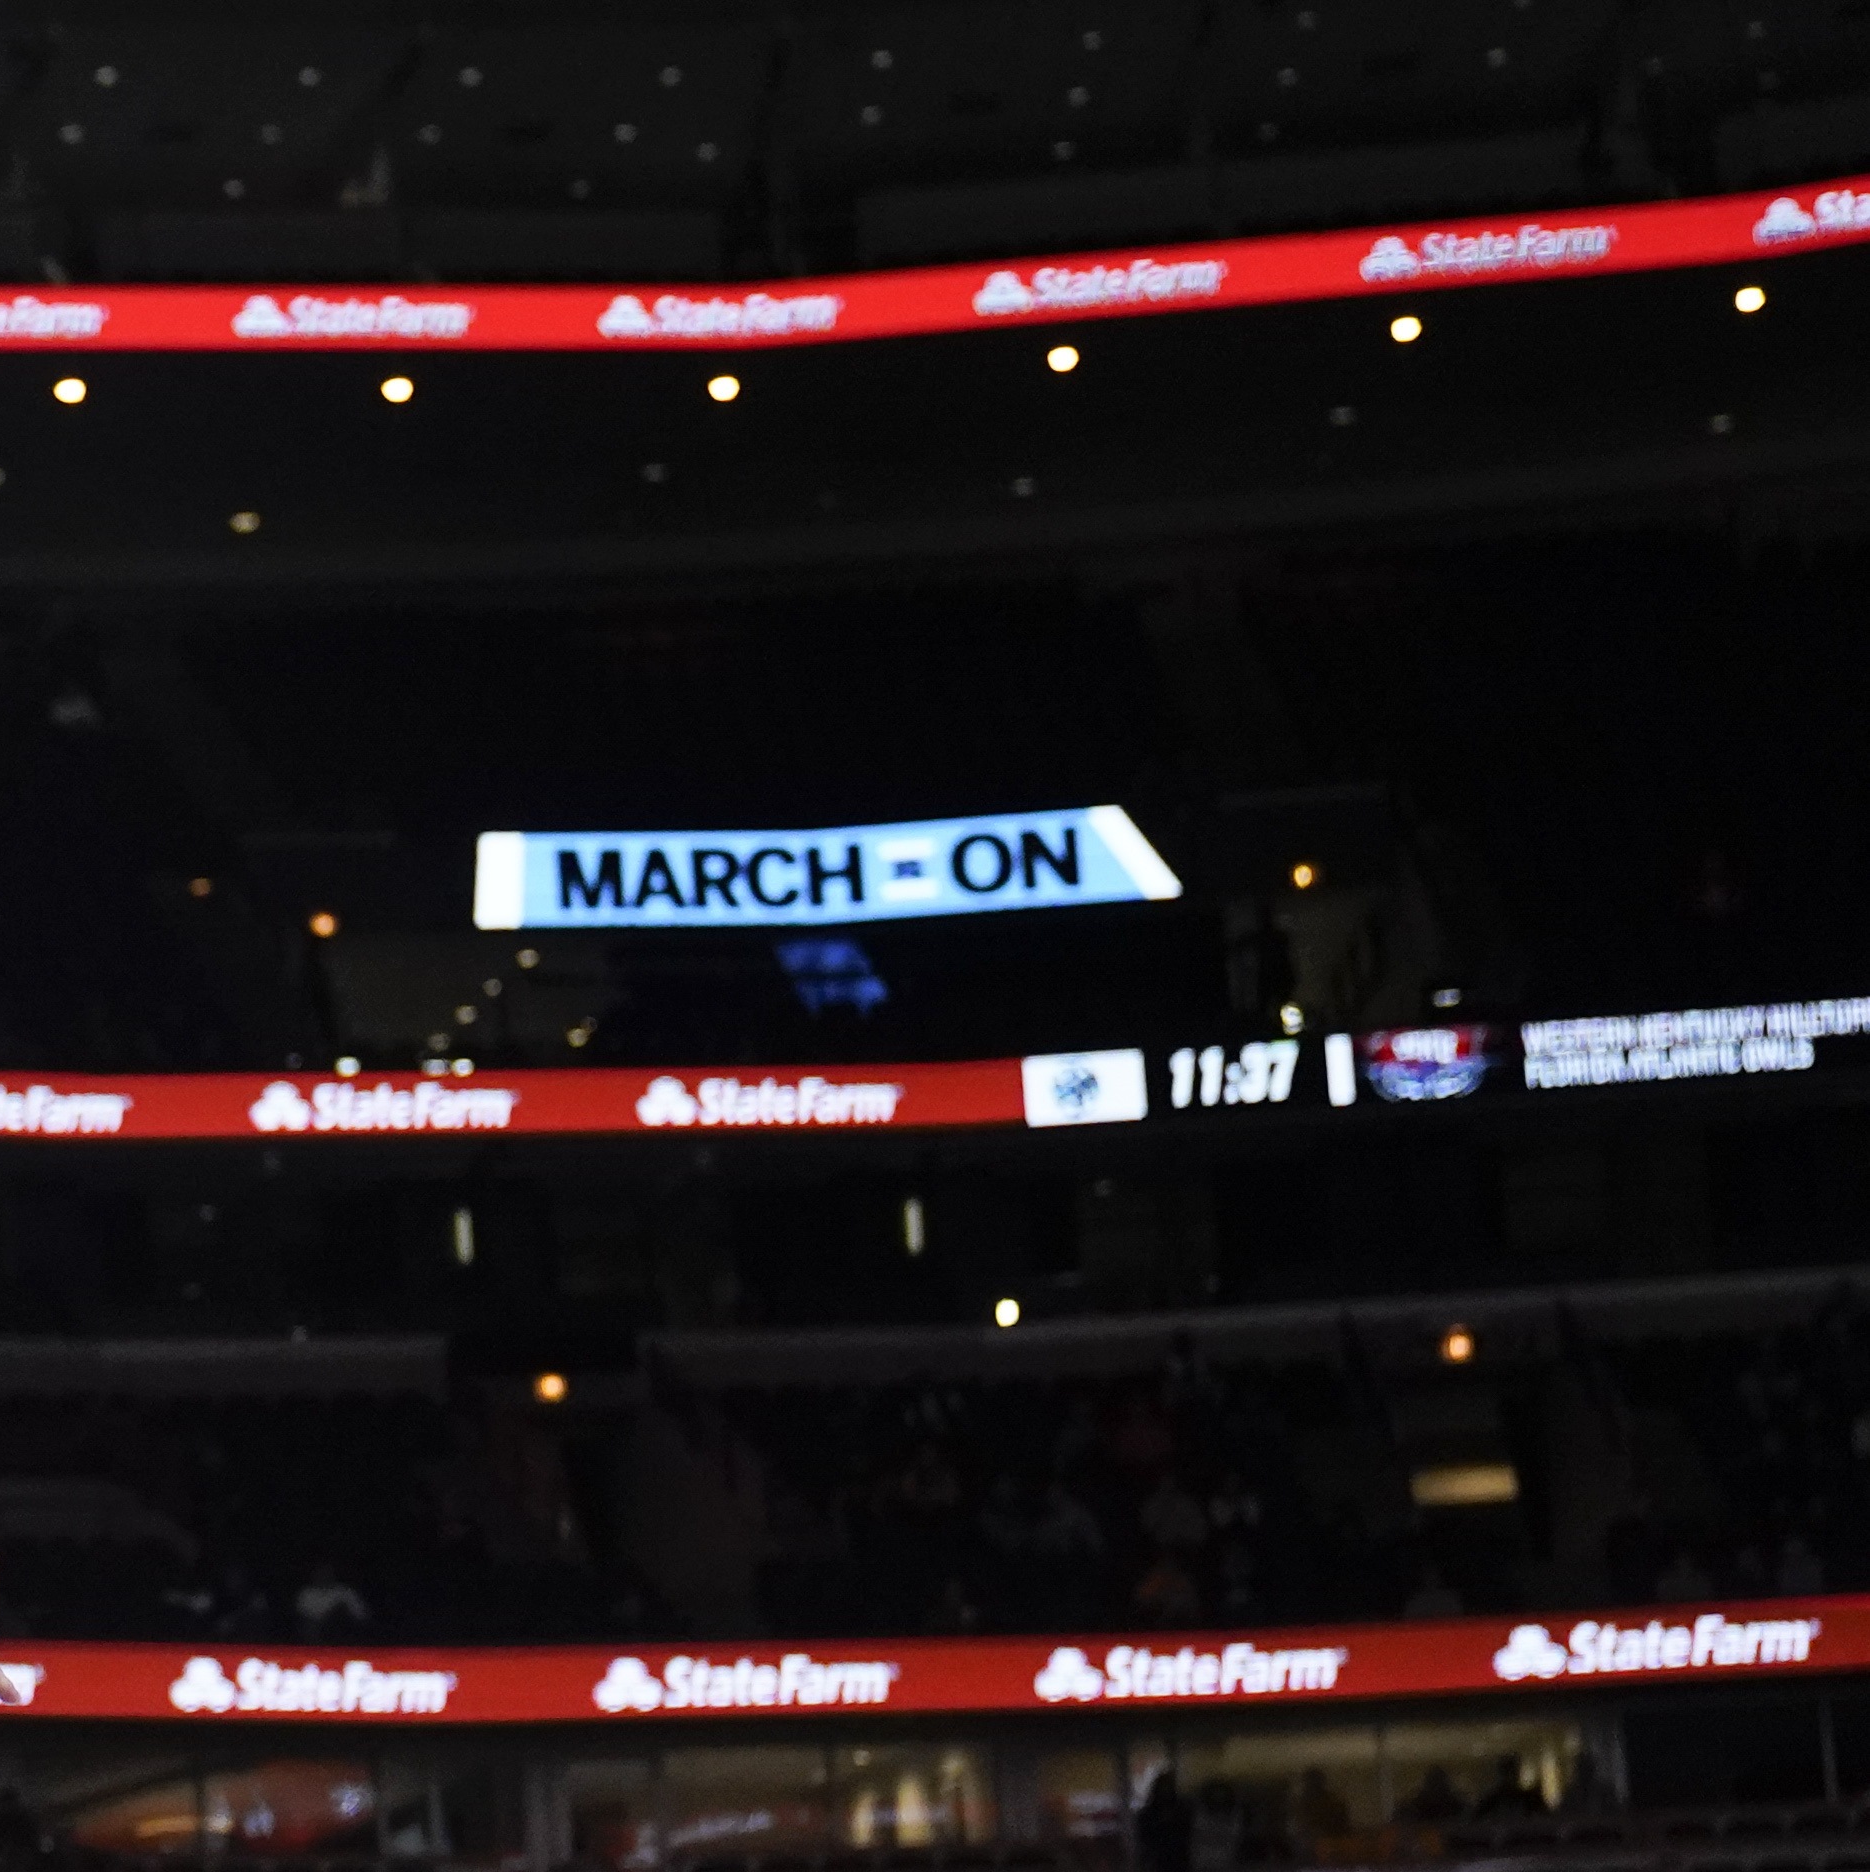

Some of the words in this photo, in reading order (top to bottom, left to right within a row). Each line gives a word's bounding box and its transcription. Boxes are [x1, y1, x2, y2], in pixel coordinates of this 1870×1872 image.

[556, 843, 865, 911] MARCH
[952, 827, 1081, 895] ON
[1168, 1039, 1300, 1109] 11:37
